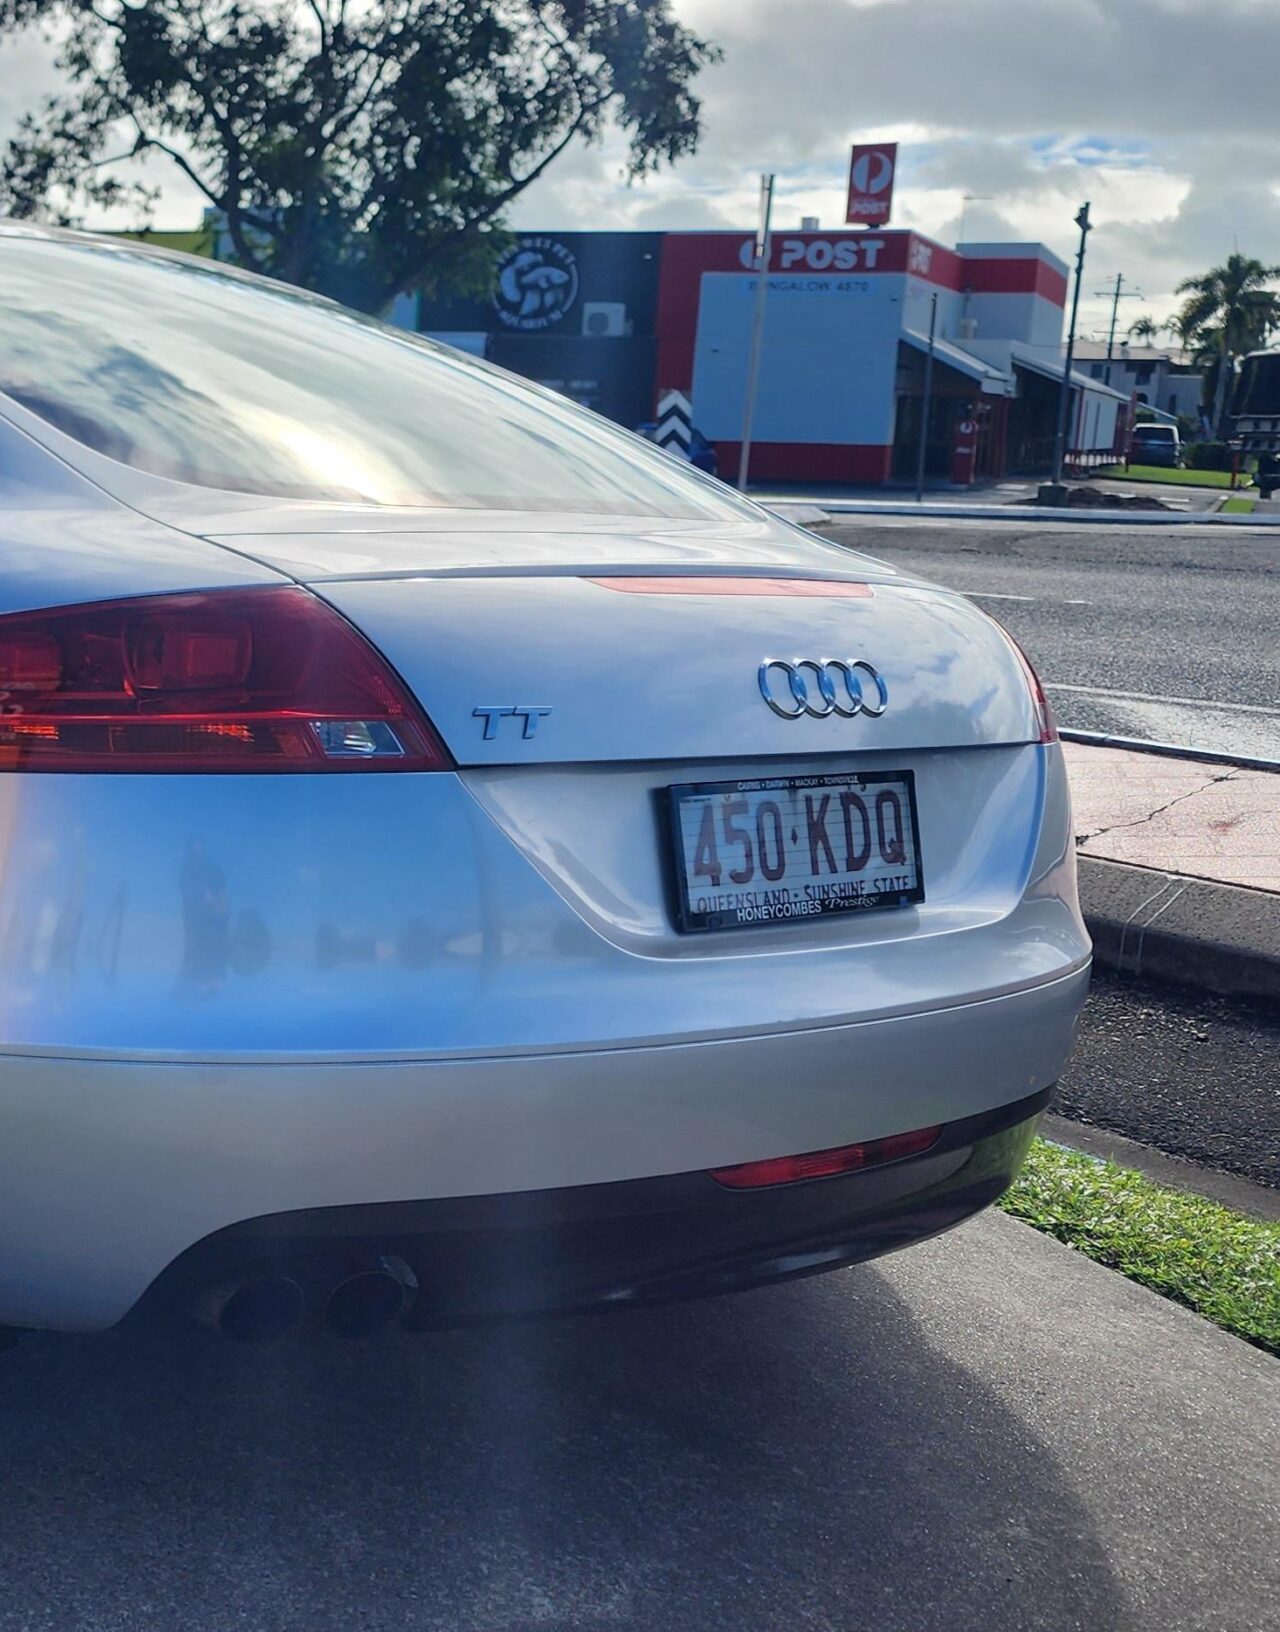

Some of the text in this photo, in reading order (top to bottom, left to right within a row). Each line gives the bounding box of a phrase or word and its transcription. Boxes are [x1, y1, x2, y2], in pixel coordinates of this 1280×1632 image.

[781, 240, 885, 270] POST
[472, 705, 553, 741] TT
[697, 876, 910, 914] QUEENSLAND SUNSHINE STATE
[737, 893, 880, 922] HONEYCOMBES Prestige
